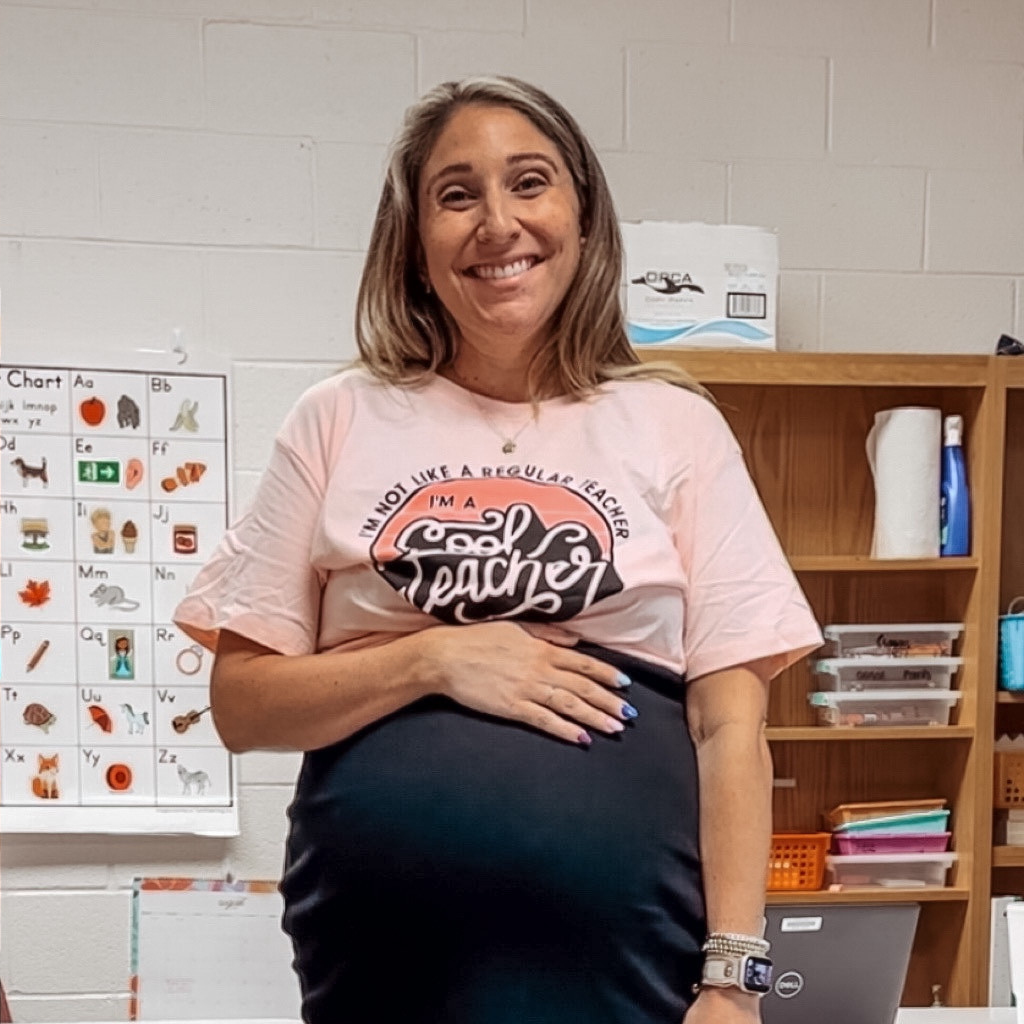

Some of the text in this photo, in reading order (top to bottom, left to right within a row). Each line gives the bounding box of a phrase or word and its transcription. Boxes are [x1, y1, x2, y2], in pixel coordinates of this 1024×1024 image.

[6, 369, 62, 389] Chart
[74, 374, 94, 389] Aa
[151, 377, 172, 392] Bb
[76, 438, 93, 453] Ee
[152, 441, 170, 456] Ff
[374, 484, 408, 517] NOT
[411, 464, 451, 487] LIKE
[461, 464, 475, 478] A
[481, 464, 575, 487] REGULAR
[429, 495, 476, 509] I'M A
[153, 505, 170, 524] Jj
[394, 502, 536, 560] Cool
[78, 565, 109, 579] Mm
[155, 566, 176, 581] Nn
[0, 625, 21, 645] Pp
[80, 626, 106, 647] Qq
[156, 628, 175, 642] Rr
[3, 687, 18, 702] Tt
[81, 688, 102, 703] Uu
[157, 689, 176, 703] Vv
[4, 749, 25, 763] Xx
[82, 749, 100, 768] Yy
[158, 749, 177, 764] Zz
